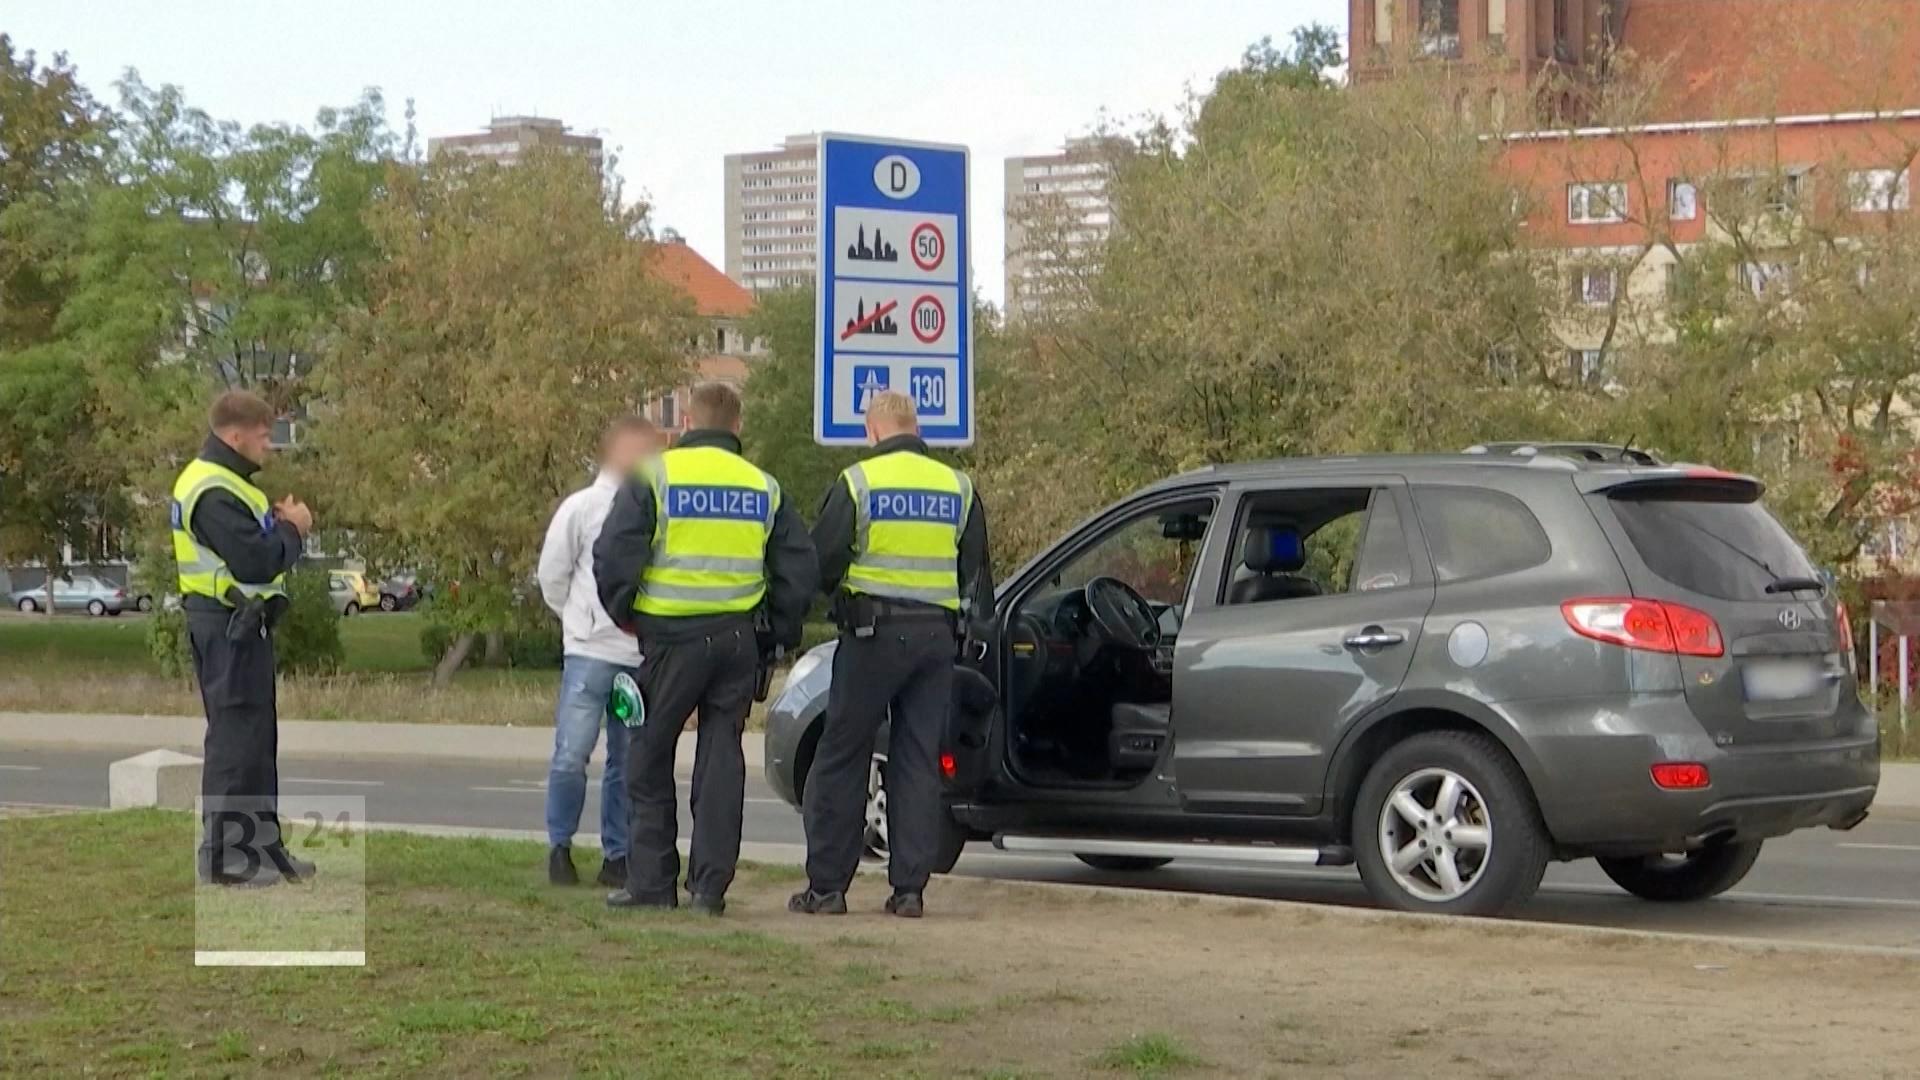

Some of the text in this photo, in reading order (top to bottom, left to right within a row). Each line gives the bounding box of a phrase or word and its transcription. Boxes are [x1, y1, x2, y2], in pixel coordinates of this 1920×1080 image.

[891, 161, 907, 192] D
[918, 235, 938, 258] 50
[918, 307, 939, 331] 100
[912, 375, 944, 408] 130
[676, 489, 762, 516] POLIZEI
[877, 493, 956, 519] POLIZEI
